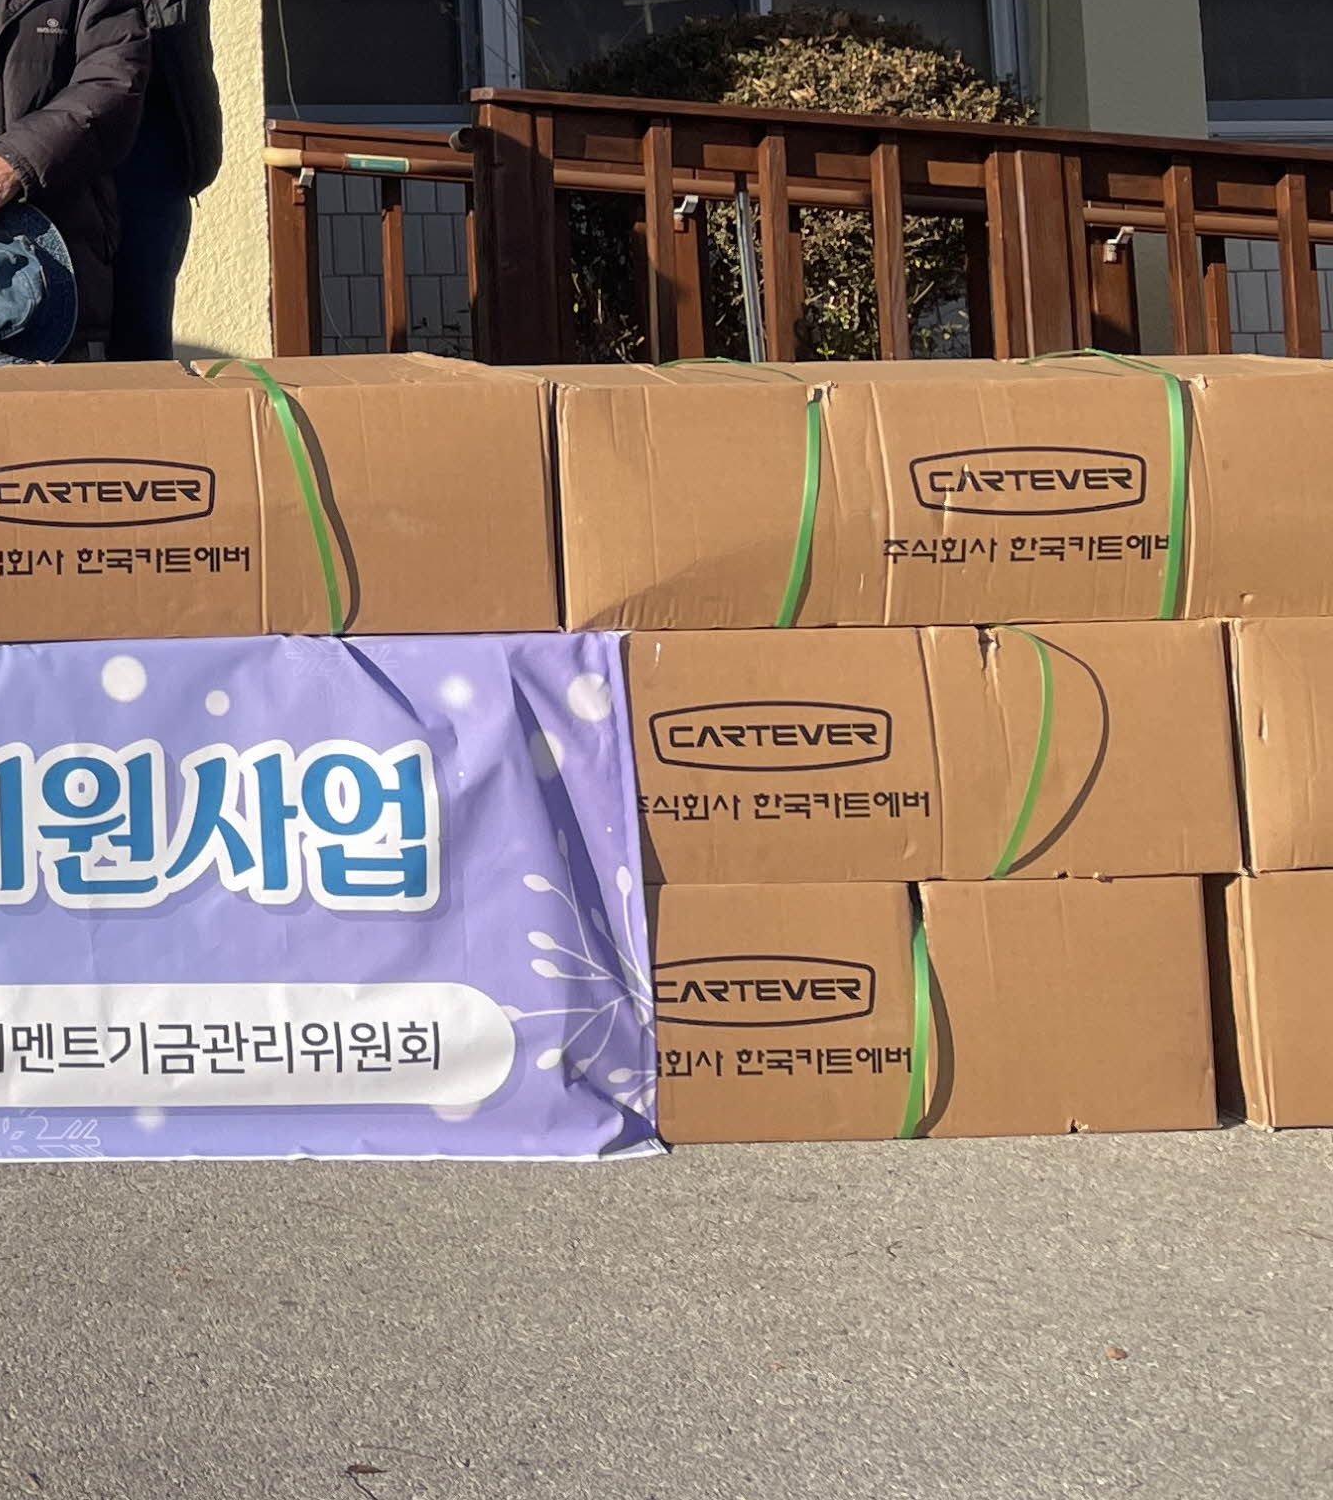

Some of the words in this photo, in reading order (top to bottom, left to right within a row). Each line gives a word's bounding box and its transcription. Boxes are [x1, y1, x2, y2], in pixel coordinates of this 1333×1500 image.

[928, 467, 1134, 493] CARTEVER
[76, 543, 250, 575] 한국카트에버
[882, 532, 998, 565] 주식회사
[668, 723, 878, 748] CARTEVER
[753, 791, 930, 820] 한국카트에버
[654, 978, 862, 1004] CARTEVER
[736, 1045, 913, 1077] 한국카트에버
